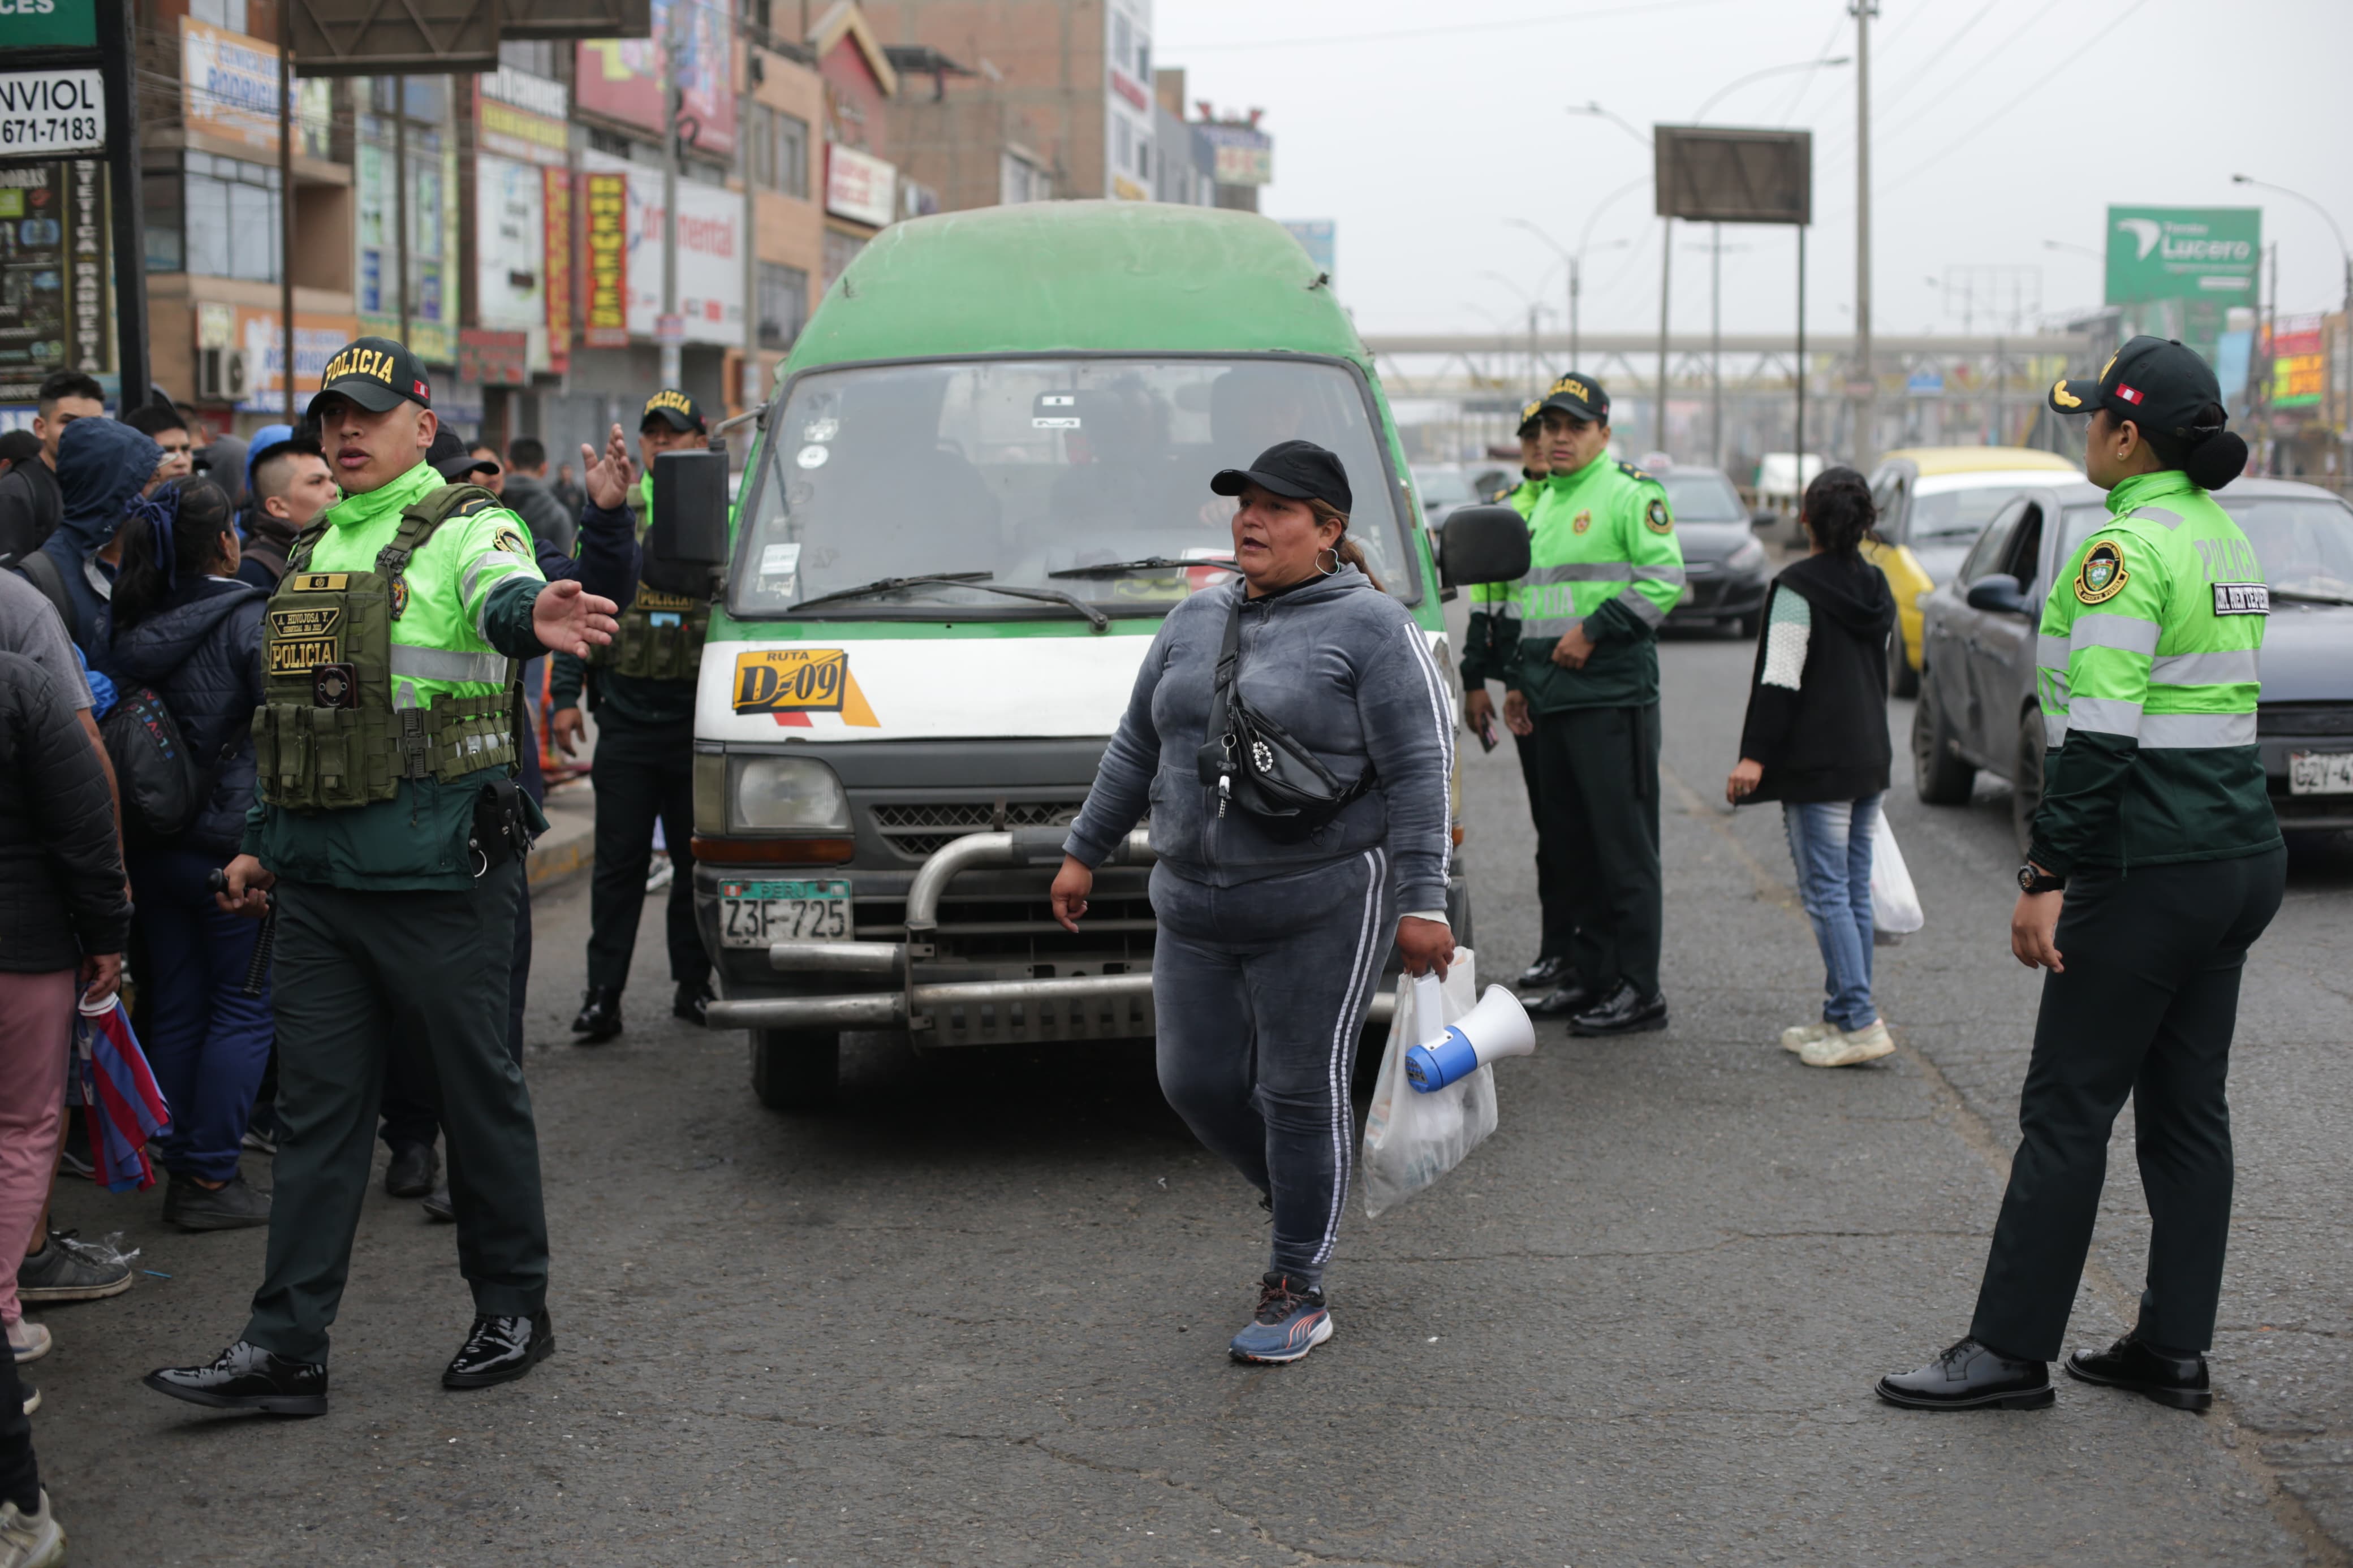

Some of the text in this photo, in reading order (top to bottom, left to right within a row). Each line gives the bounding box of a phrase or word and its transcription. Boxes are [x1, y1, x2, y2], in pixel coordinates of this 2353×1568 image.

[2, 117, 97, 143] 671-7183
[589, 176, 623, 326] BREVETES
[2160, 233, 2251, 260] Lucero
[324, 348, 394, 390] POLICIA
[644, 390, 691, 416] POLICIA
[287, 612, 320, 625] HINOJOSA
[271, 642, 334, 670] POLICIA
[766, 651, 809, 662] RUTA
[738, 663, 839, 703] D-09
[761, 882, 807, 899] PERU
